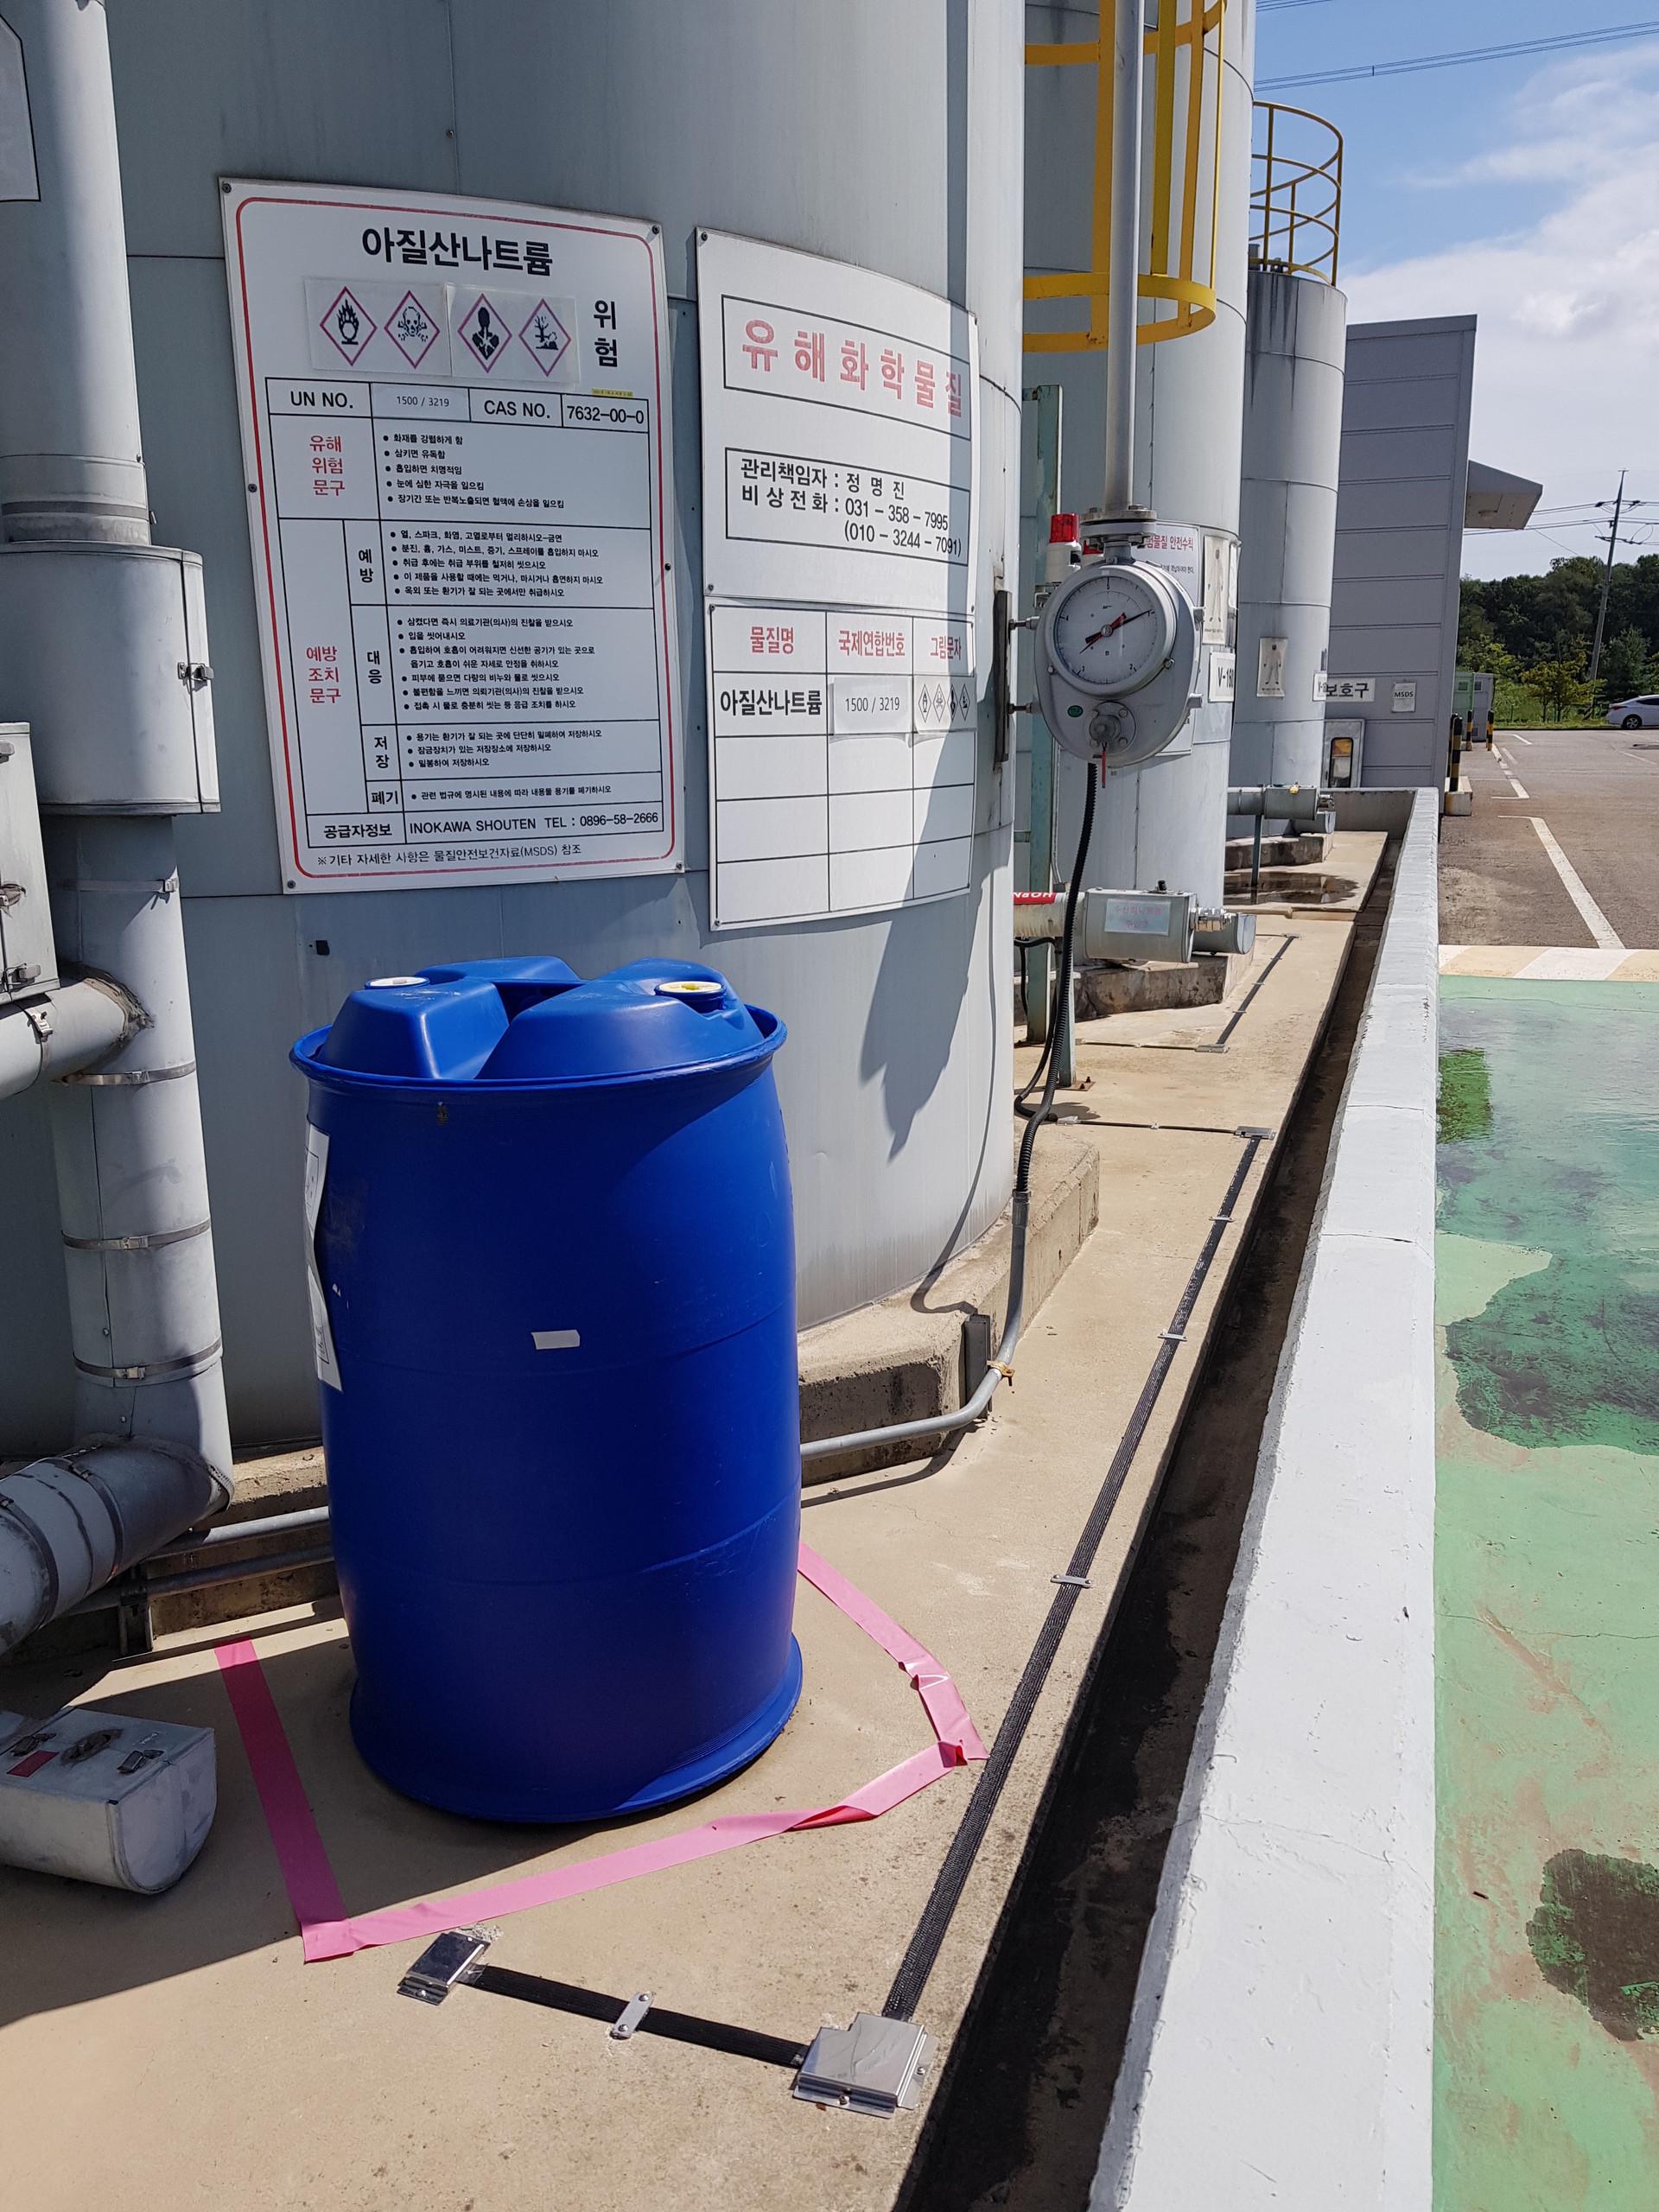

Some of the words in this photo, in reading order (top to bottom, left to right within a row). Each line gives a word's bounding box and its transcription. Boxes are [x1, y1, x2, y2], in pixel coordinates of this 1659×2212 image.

[362, 226, 554, 276] 아질산나트륨
[290, 391, 315, 406] UN
[322, 392, 353, 409] NO.
[397, 397, 417, 405] 1500
[429, 397, 449, 407] 3219
[485, 400, 517, 416] CAS
[523, 403, 550, 418] NO.
[567, 406, 644, 423] 7632-00-0
[309, 435, 341, 452] 유해
[394, 434, 416, 442] 화재를
[455, 436, 462, 445] 함
[395, 449, 418, 458] 삼키면
[422, 450, 445, 459] 유독함
[312, 458, 342, 474] 위험
[397, 464, 427, 474] 흡입하면
[431, 466, 461, 474] 치명적임
[741, 459, 827, 488] 관리책임자
[314, 480, 345, 496] 문구
[397, 480, 413, 488] 눈에
[416, 480, 431, 488] 심한
[435, 480, 458, 489] 자극을
[398, 494, 422, 503] 장기간
[425, 495, 441, 504] 또는
[443, 496, 489, 505] 반복노출되면
[518, 499, 539, 507] 손상을
[404, 558, 418, 567] 취급
[422, 558, 445, 567] 후에는
[448, 559, 463, 568] 취급
[493, 560, 514, 569] 철저히
[518, 561, 546, 569] 씻으시오
[404, 572, 411, 581] 이
[442, 573, 464, 582] 사용할
[521, 575, 549, 583] 마시거나
[442, 587, 465, 595] 환기가
[497, 588, 525, 596] 곳에서만
[529, 588, 564, 597] 취급하시오
[442, 618, 456, 626] 즉시
[545, 619, 573, 627] 받으시오
[409, 632, 423, 640] 입을
[427, 632, 466, 640] 씻어내시오
[750, 626, 793, 654] 물질명
[839, 631, 905, 657] 국제연합번호
[930, 635, 962, 661] 그림문자
[307, 646, 337, 662] 예방
[308, 667, 339, 683] 조치
[310, 689, 341, 703] 문구
[1325, 683, 1370, 698] 보호구
[721, 690, 822, 715] 아질산나트륨
[846, 698, 868, 711] 1500
[880, 697, 899, 710] 3219
[416, 733, 439, 741] 용기는
[418, 746, 455, 754] 잠금장치가
[578, 785, 611, 794] 폐기하시오
[372, 791, 398, 804] 폐기
[410, 821, 472, 834] INOKAWA
[476, 818, 536, 831] SHOUTEN
[544, 817, 567, 828] TEL
[580, 812, 658, 826] 0896-58-2666
[324, 823, 392, 839] 공급자정보
[357, 853, 391, 864] 자세한
[396, 851, 429, 862] 사항은
[562, 844, 581, 855] 참조
